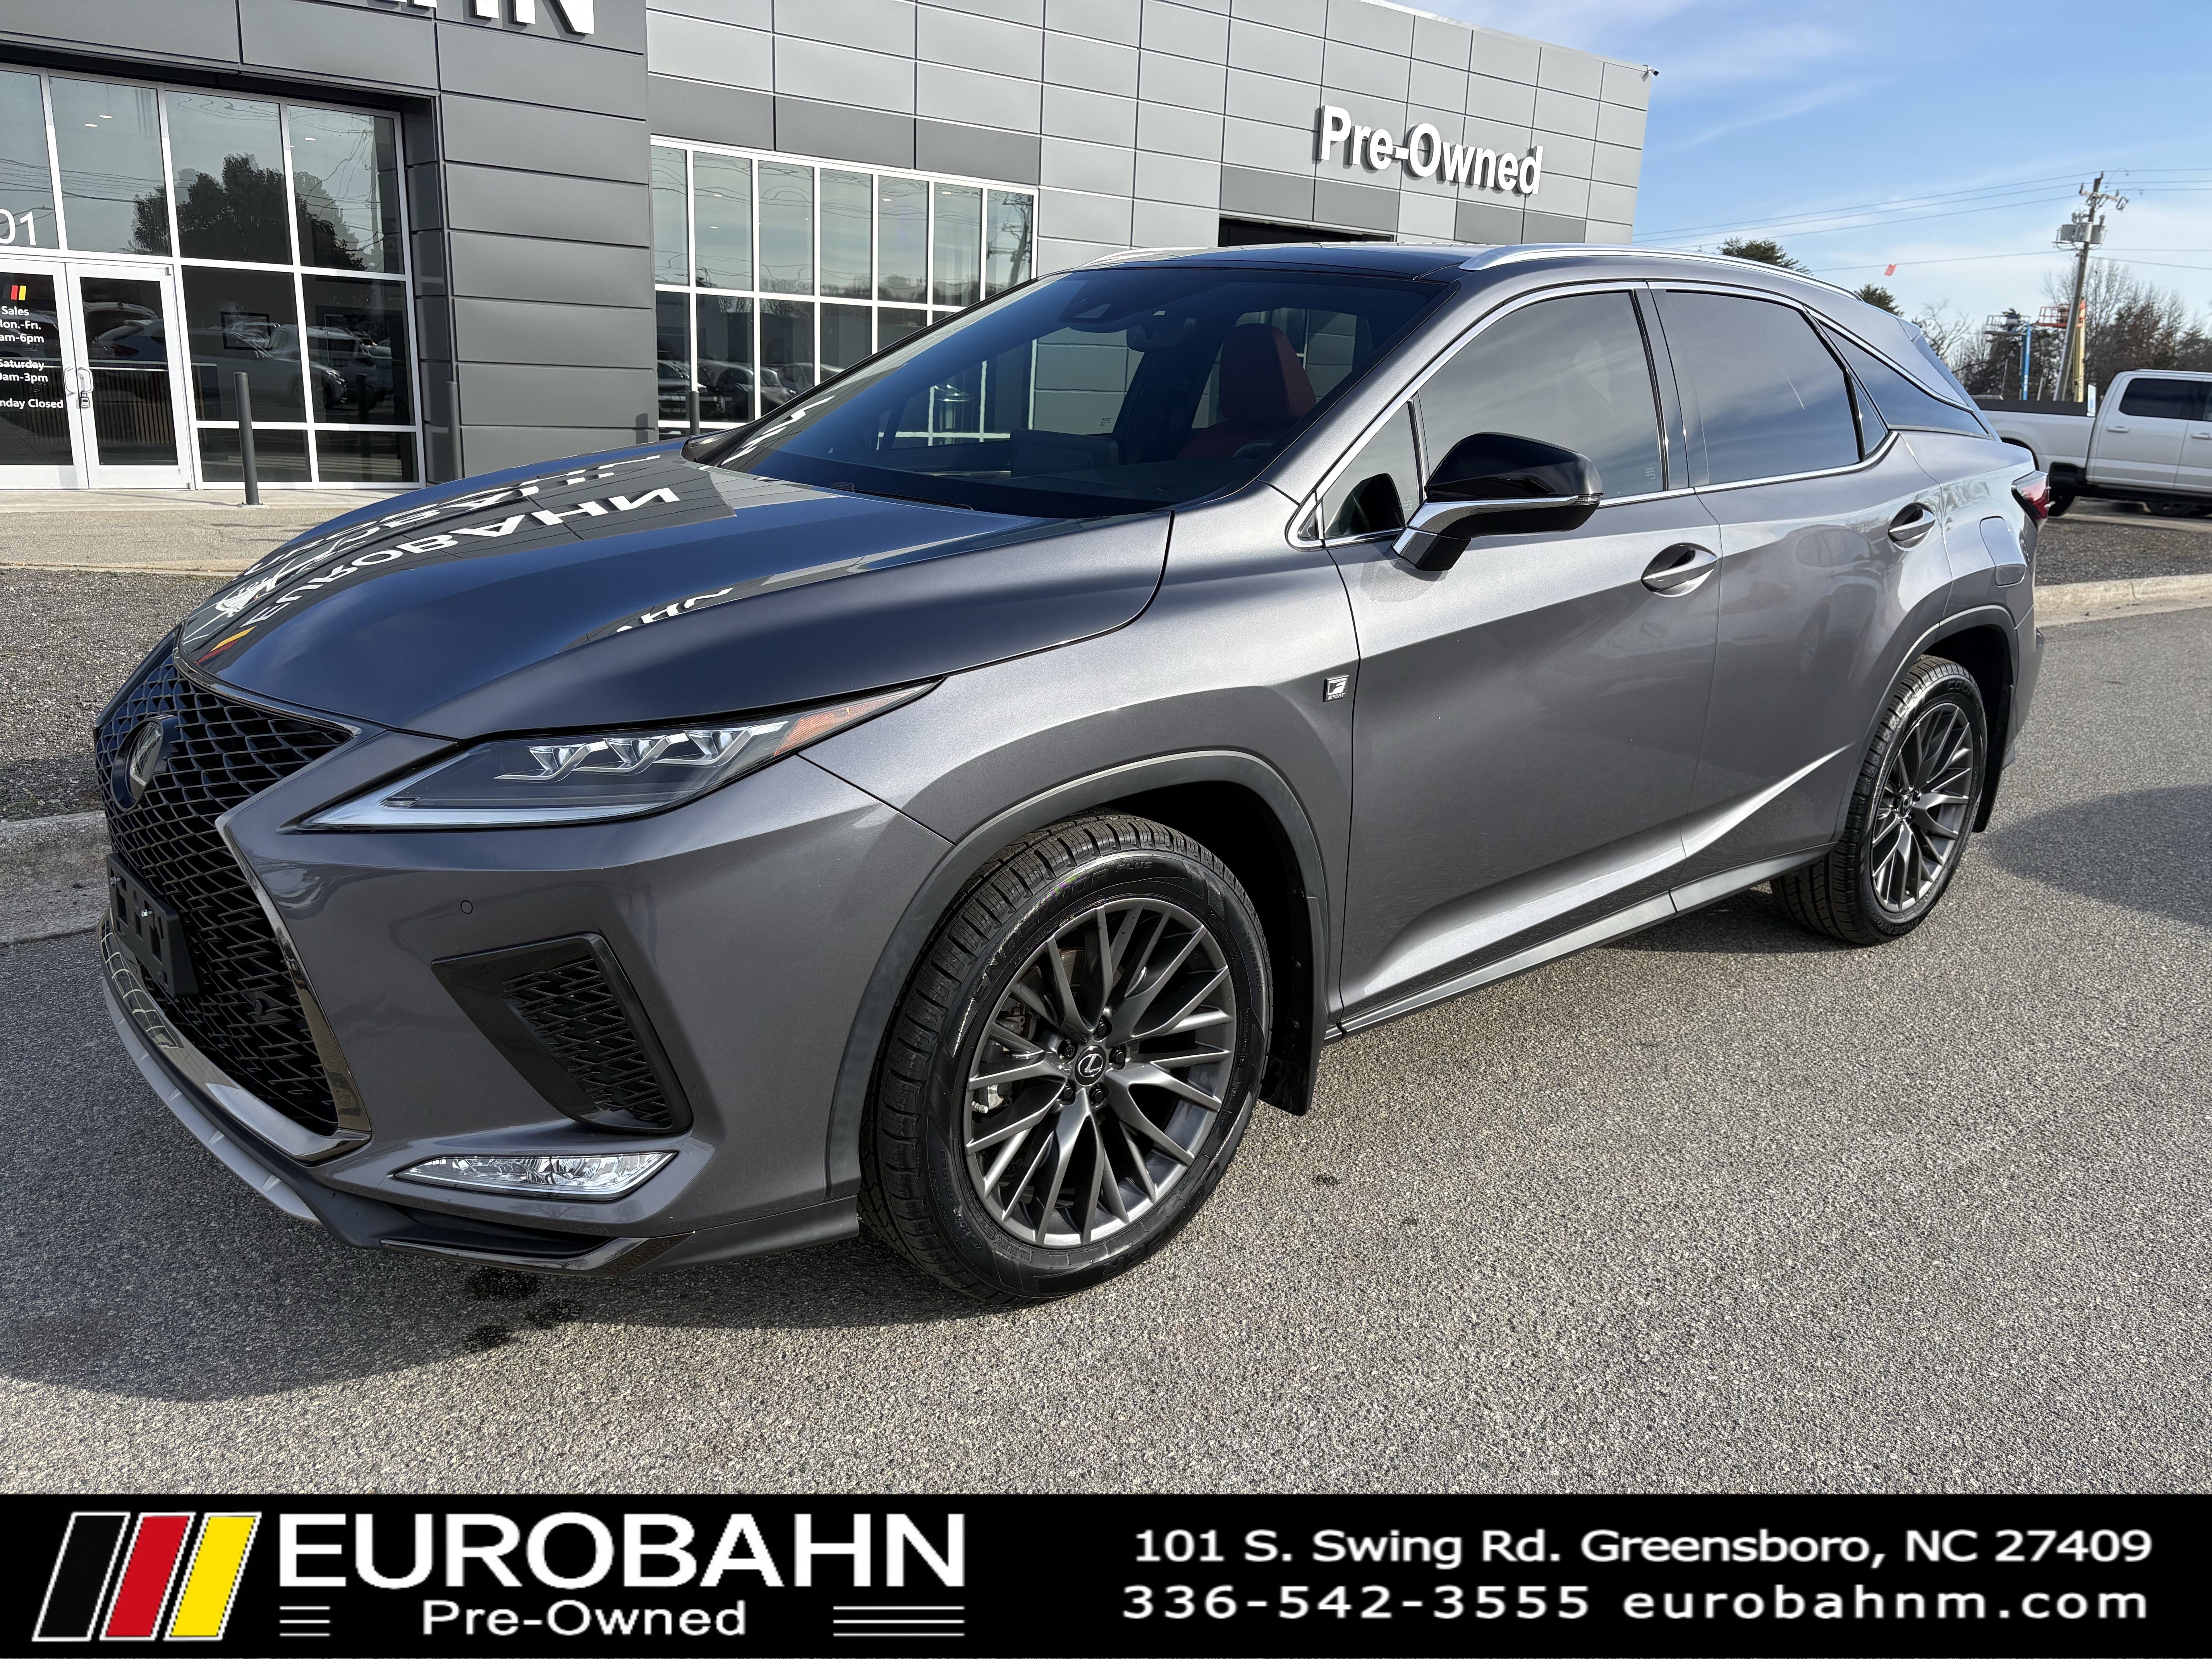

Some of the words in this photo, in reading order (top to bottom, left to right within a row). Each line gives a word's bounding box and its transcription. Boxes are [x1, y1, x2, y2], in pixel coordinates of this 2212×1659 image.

[1319, 105, 1544, 195] Pre-Owned
[1, 306, 30, 316] Sales
[0, 359, 45, 371] Saturday
[28, 398, 64, 408] Closed
[1327, 692, 1346, 700] SPORT
[1115, 861, 1153, 874] PLUS
